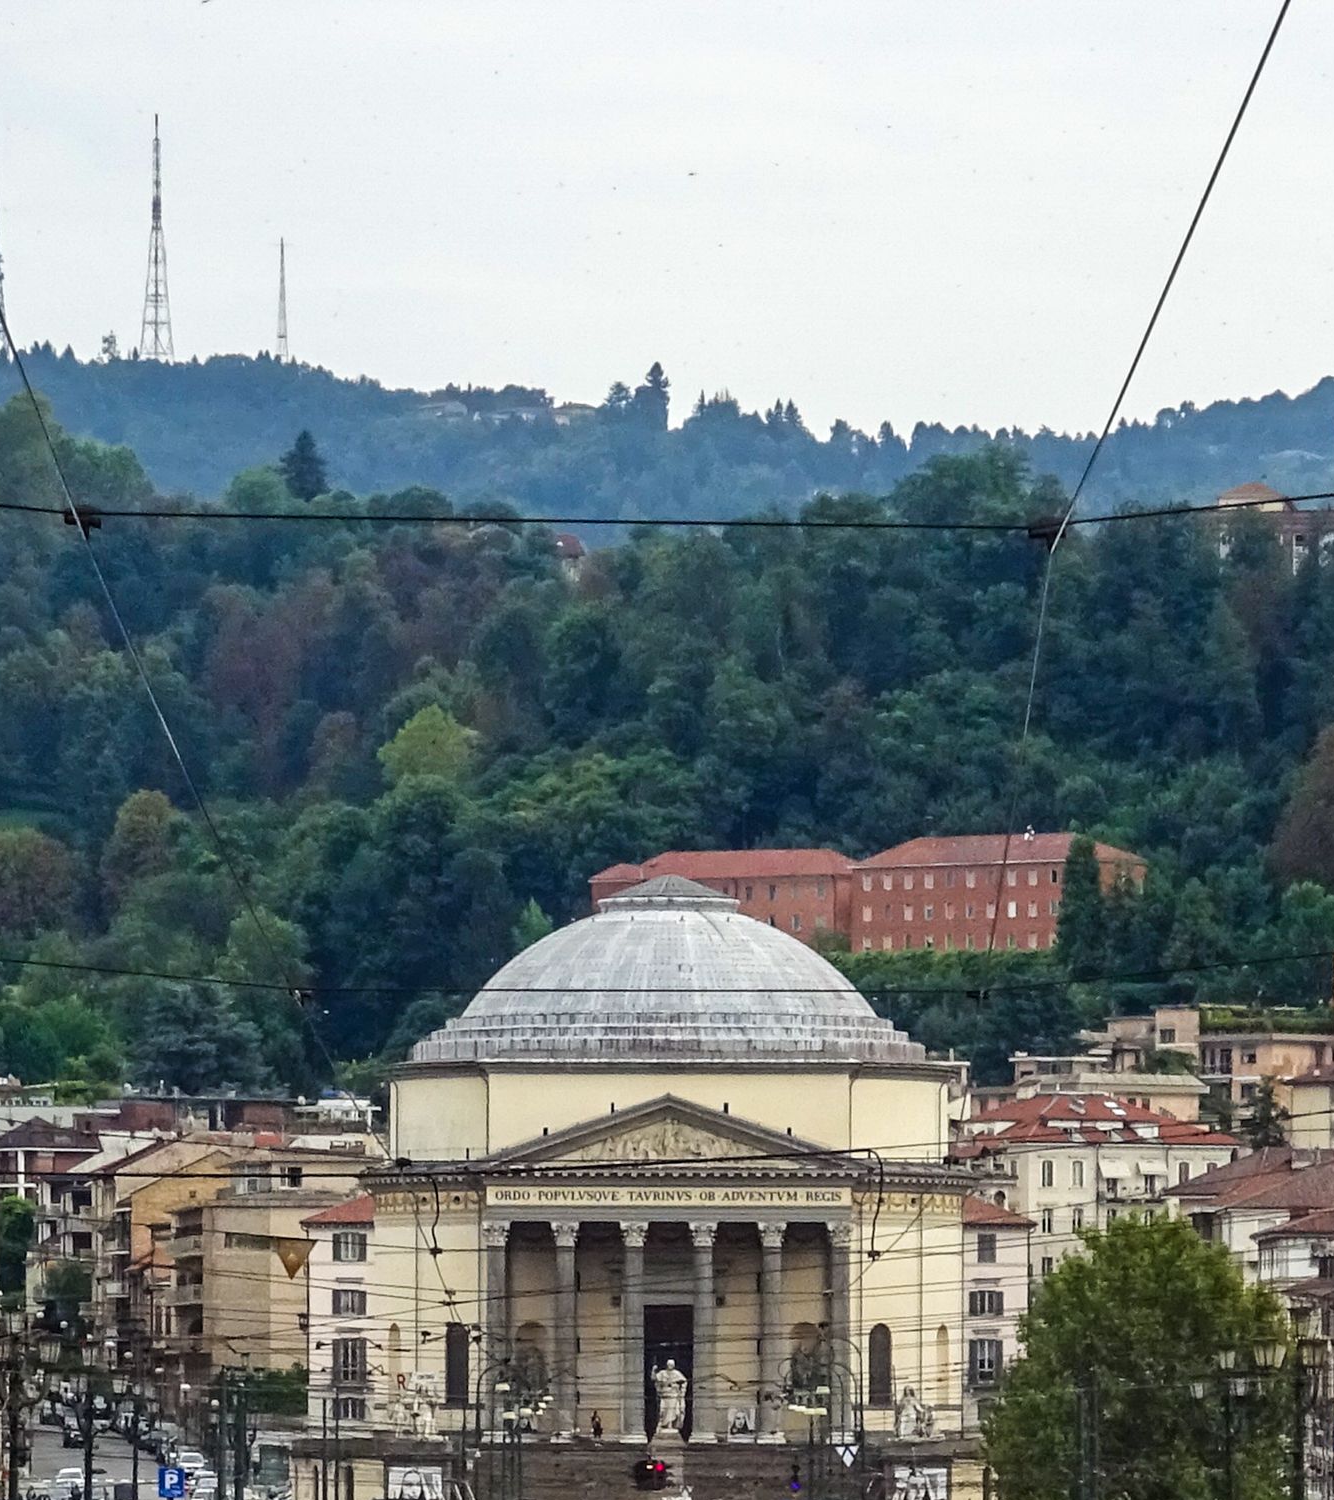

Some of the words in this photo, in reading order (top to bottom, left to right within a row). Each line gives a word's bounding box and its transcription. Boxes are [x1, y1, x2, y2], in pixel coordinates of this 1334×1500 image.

[495, 1190, 531, 1201] ORDO
[629, 1190, 692, 1201] TAVRINVS
[699, 1190, 716, 1201] OB
[721, 1190, 797, 1201] ADVENTVM
[805, 1190, 842, 1201] REGIS
[164, 1473, 179, 1490] P
